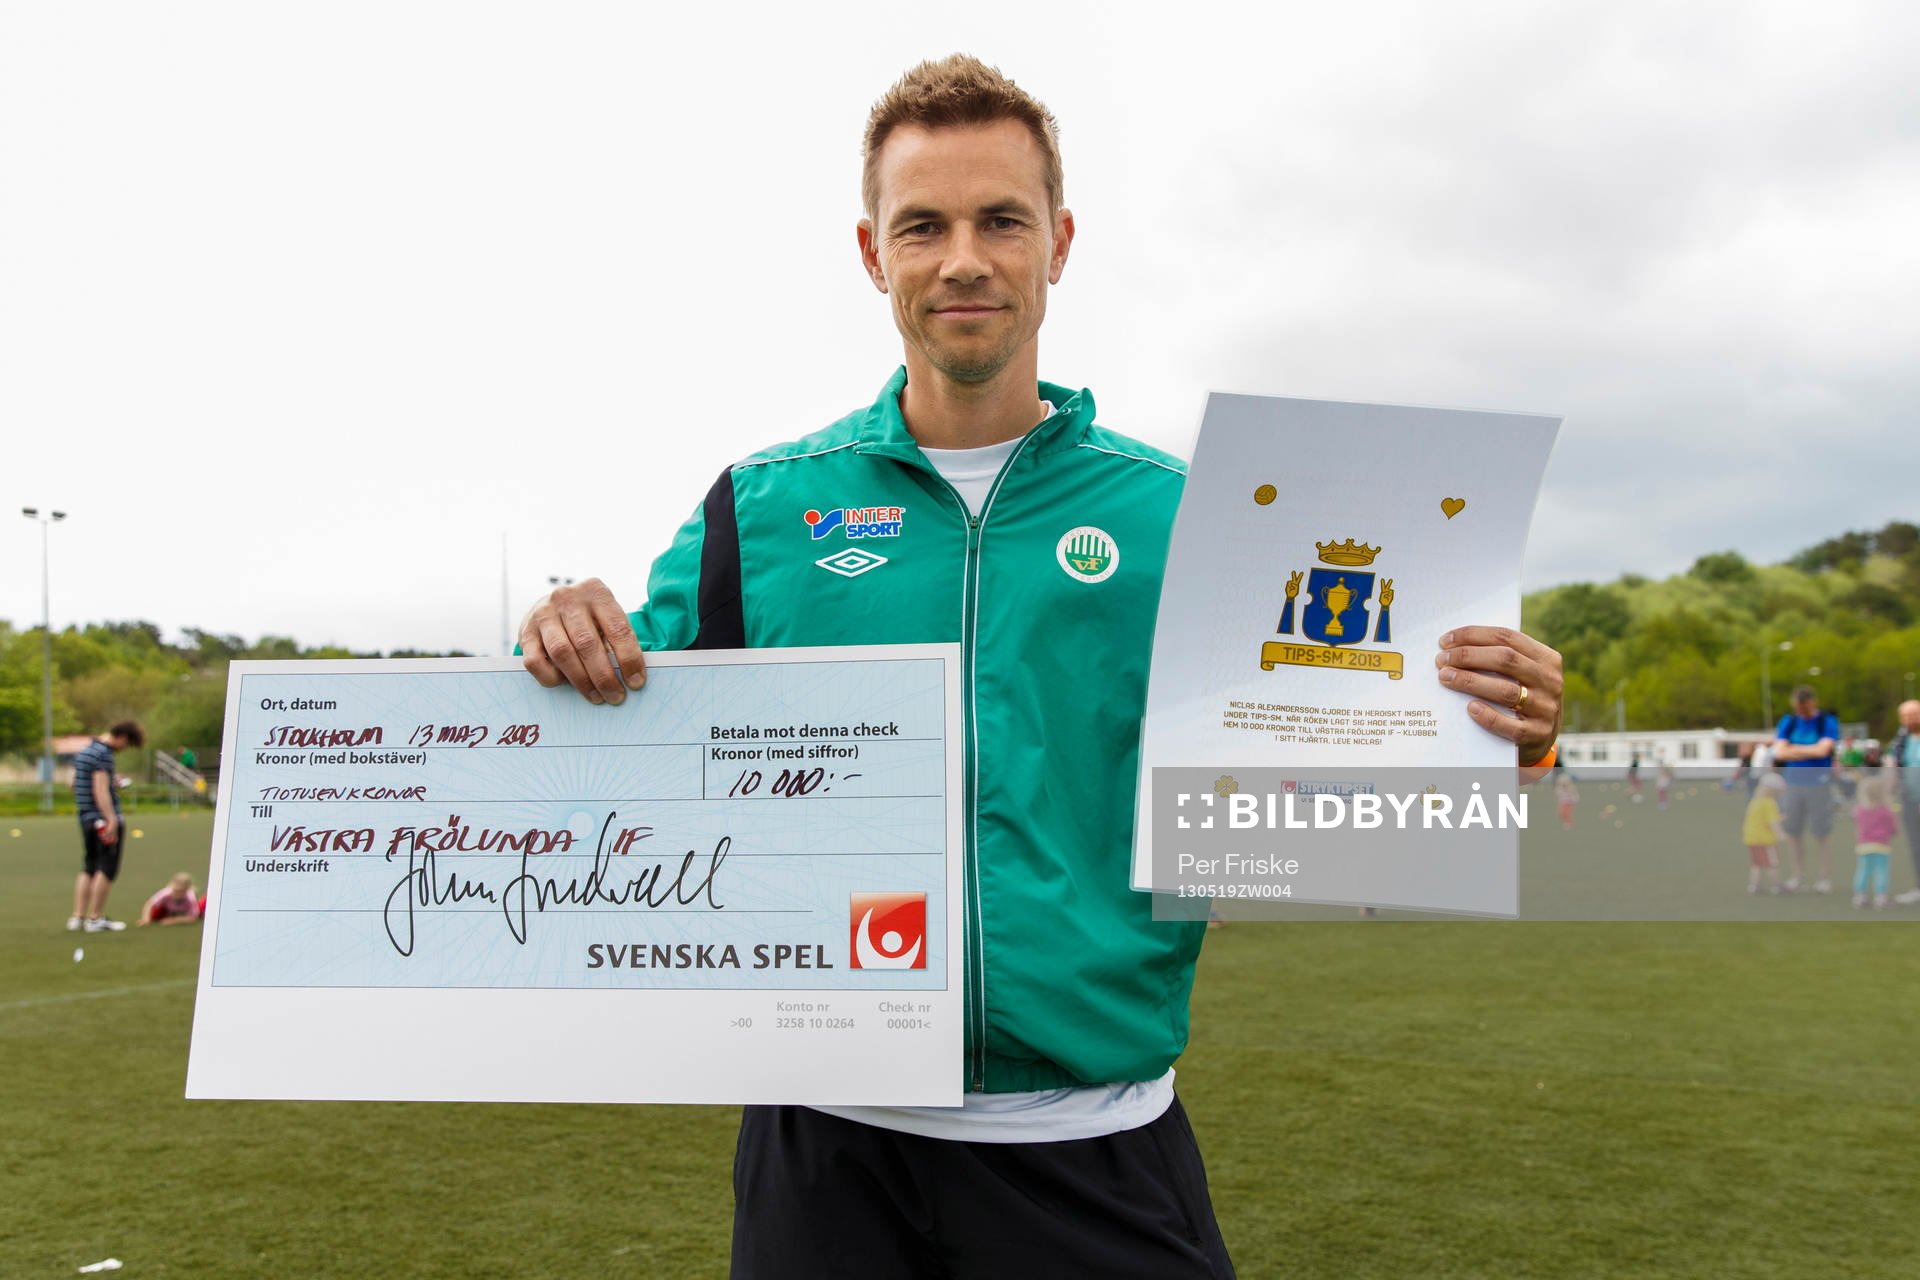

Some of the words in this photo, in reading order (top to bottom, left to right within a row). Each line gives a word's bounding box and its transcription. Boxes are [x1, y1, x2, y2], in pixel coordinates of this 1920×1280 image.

[846, 507, 901, 524] INTER
[846, 522, 902, 538] SPORT
[1283, 647, 1344, 665] TIPS-SM
[1348, 653, 1382, 668] 2013
[261, 698, 287, 711] Ort,
[291, 698, 337, 710] datum
[1230, 701, 1256, 710] NICLAS
[1257, 703, 1320, 715] ALEXANDERSSON
[1321, 708, 1351, 716] GJORDE
[1353, 709, 1363, 717] EN
[1404, 710, 1432, 718] INSATS
[1224, 711, 1248, 719] UNDER
[1330, 718, 1350, 726] LAGT
[1352, 719, 1365, 727] SIG
[1367, 719, 1387, 727] HADE
[264, 725, 383, 747] STOCKHOLM
[409, 724, 434, 747] 13
[436, 725, 488, 748] MAJ
[711, 725, 760, 740] Betala
[763, 727, 796, 739] mot
[799, 724, 849, 738] denna
[853, 722, 899, 736] check
[1223, 721, 1239, 729] HEM
[1241, 722, 1249, 730] 10
[1249, 723, 1264, 731] 000
[1266, 724, 1296, 733] KRONOR
[1298, 726, 1313, 734] TILL
[1403, 729, 1438, 737] KLUBBEN
[1353, 738, 1383, 746] NICLAS!
[256, 752, 306, 765] Kronor
[309, 751, 346, 766] (med
[349, 751, 427, 766] bokstäver)
[711, 747, 763, 761] Kronor
[766, 746, 804, 761] (med
[808, 745, 859, 761] siffror)
[728, 769, 762, 798] 10
[251, 805, 273, 818] Till
[271, 824, 375, 852] VÄSTRA
[246, 860, 329, 873] Underskrift
[587, 943, 741, 969] SVENSKA
[752, 943, 834, 969] SPEL
[776, 1001, 814, 1013] Konto
[817, 1003, 831, 1013] nr
[878, 1002, 914, 1014] Check
[918, 1003, 932, 1014] nr
[776, 1018, 805, 1029] 3258
[809, 1018, 823, 1029] 10
[826, 1018, 855, 1029] 0264
